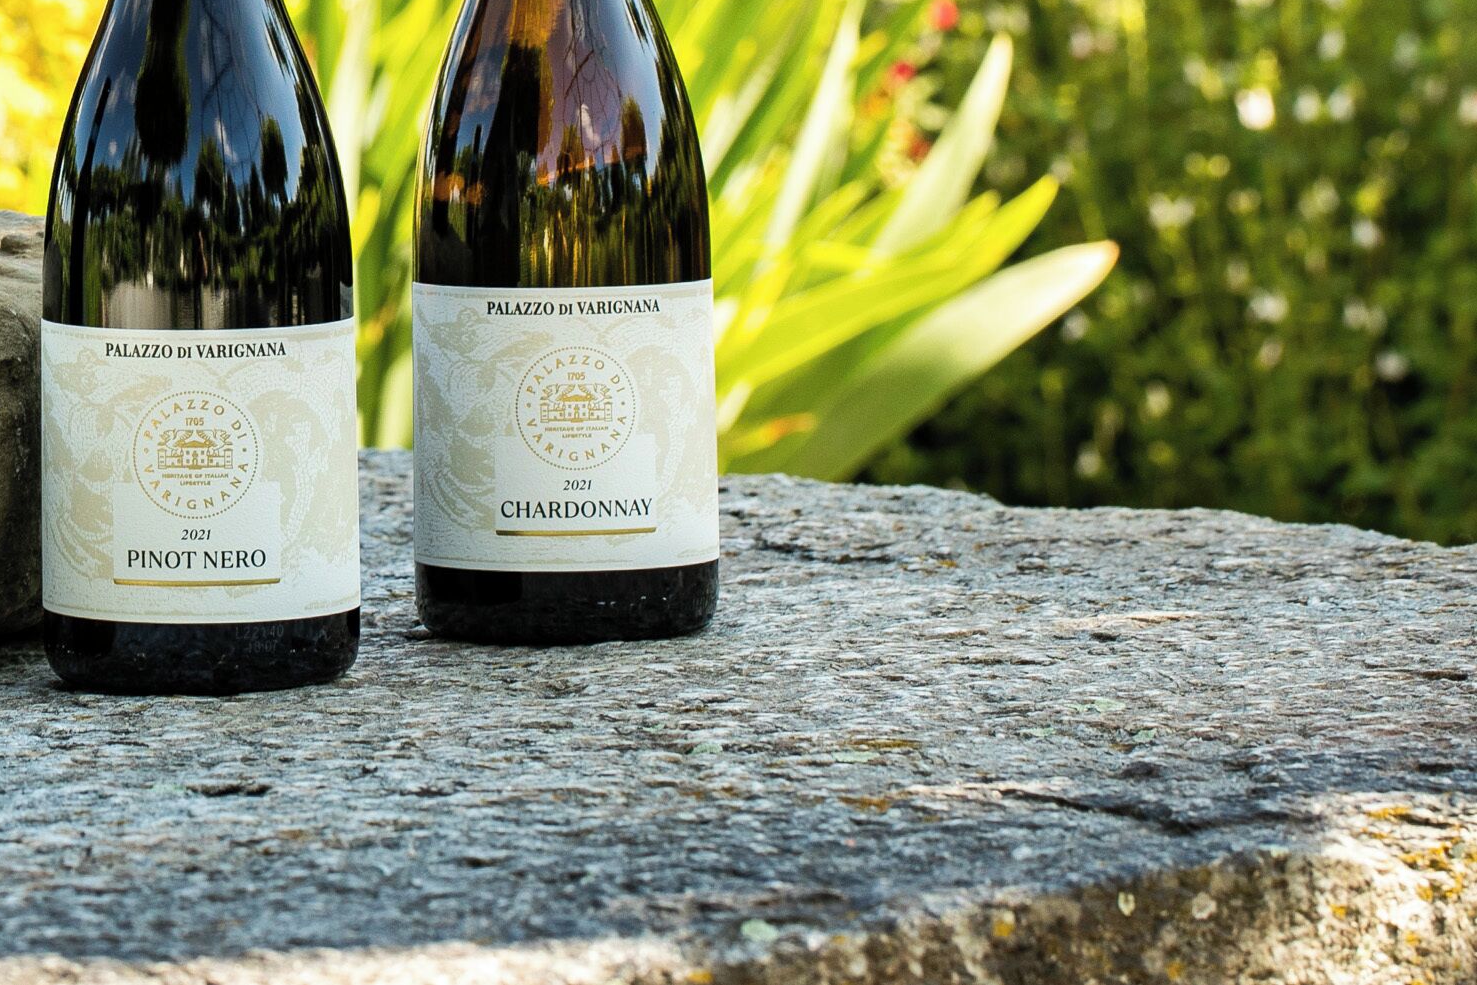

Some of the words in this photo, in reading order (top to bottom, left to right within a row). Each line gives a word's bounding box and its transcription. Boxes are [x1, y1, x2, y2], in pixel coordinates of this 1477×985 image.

[487, 300, 554, 316] PALAZZO
[559, 304, 573, 316] DI
[576, 298, 660, 315] VARIGNANA
[105, 342, 173, 358] PALAZZO
[177, 346, 192, 358] DI
[196, 342, 286, 358] VARIGNANA
[526, 355, 604, 395] PALAZZO
[610, 374, 626, 392] DI
[144, 399, 224, 440] PALAZZO
[231, 420, 247, 439] DI
[186, 418, 204, 426] 1705
[526, 415, 626, 462] VARIGNANA
[144, 464, 248, 510] VARIGNANA
[563, 480, 592, 491] 2021
[500, 498, 653, 518] CHARDONNAY
[180, 528, 211, 541] 2021
[127, 549, 197, 570] PINOT
[203, 549, 266, 570] NERO
